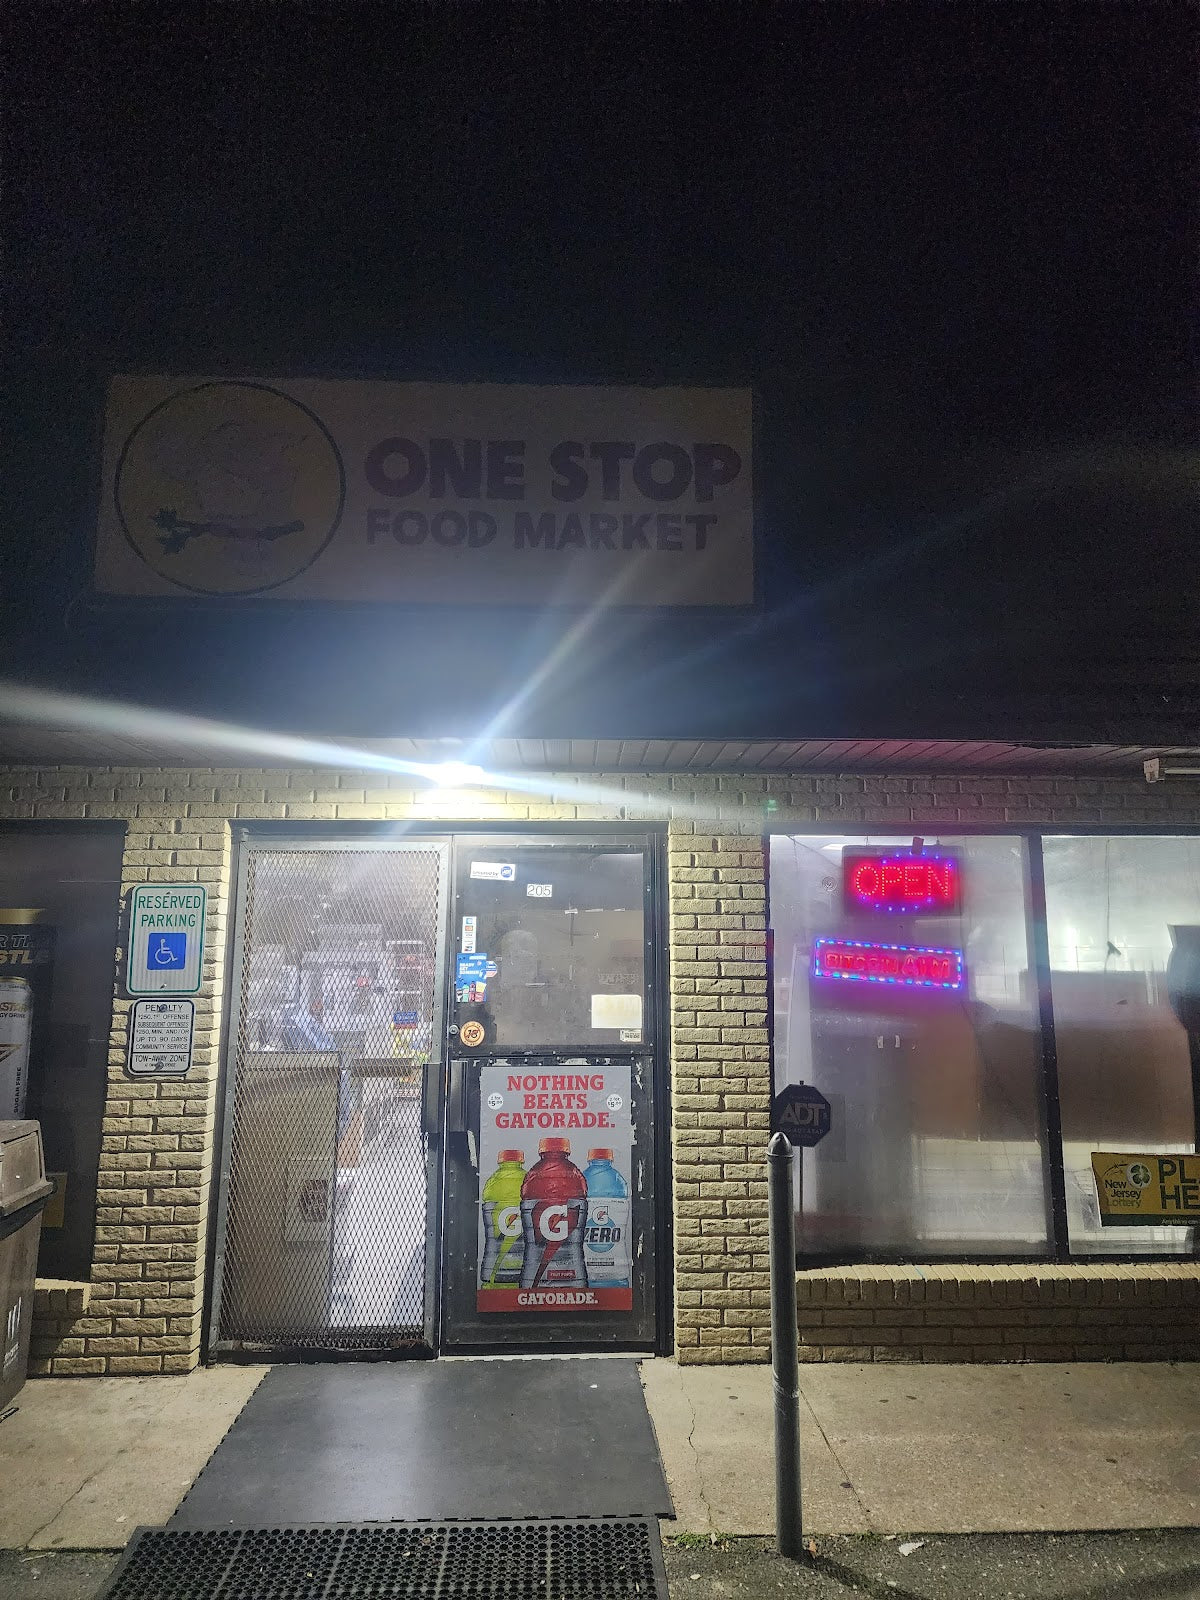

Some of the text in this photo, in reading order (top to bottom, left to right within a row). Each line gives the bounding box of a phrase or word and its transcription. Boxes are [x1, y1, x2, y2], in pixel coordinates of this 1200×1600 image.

[364, 437, 743, 504] ONE STOP
[366, 508, 719, 552] FOOD MARKET
[855, 865, 950, 896] OPEN
[527, 884, 551, 896] 205
[138, 895, 201, 909] RESERVED
[141, 914, 196, 928] PARKING
[145, 1004, 183, 1012] PENLTY
[135, 1055, 187, 1063] TOW-AWAY ZONE
[507, 1075, 604, 1092] NOTHING
[523, 1093, 588, 1110] BEATS
[495, 1112, 616, 1129] GATORADE.
[779, 1103, 826, 1126] ADT
[1158, 1160, 1200, 1184] PL
[1105, 1180, 1127, 1189] New
[1111, 1189, 1142, 1200] Jersey
[1107, 1199, 1142, 1208] Lottery
[498, 1206, 522, 1237] G
[540, 1205, 569, 1242] G
[592, 1206, 609, 1226] G
[584, 1227, 621, 1244] ZERO
[517, 1292, 599, 1306] GATORADE.
